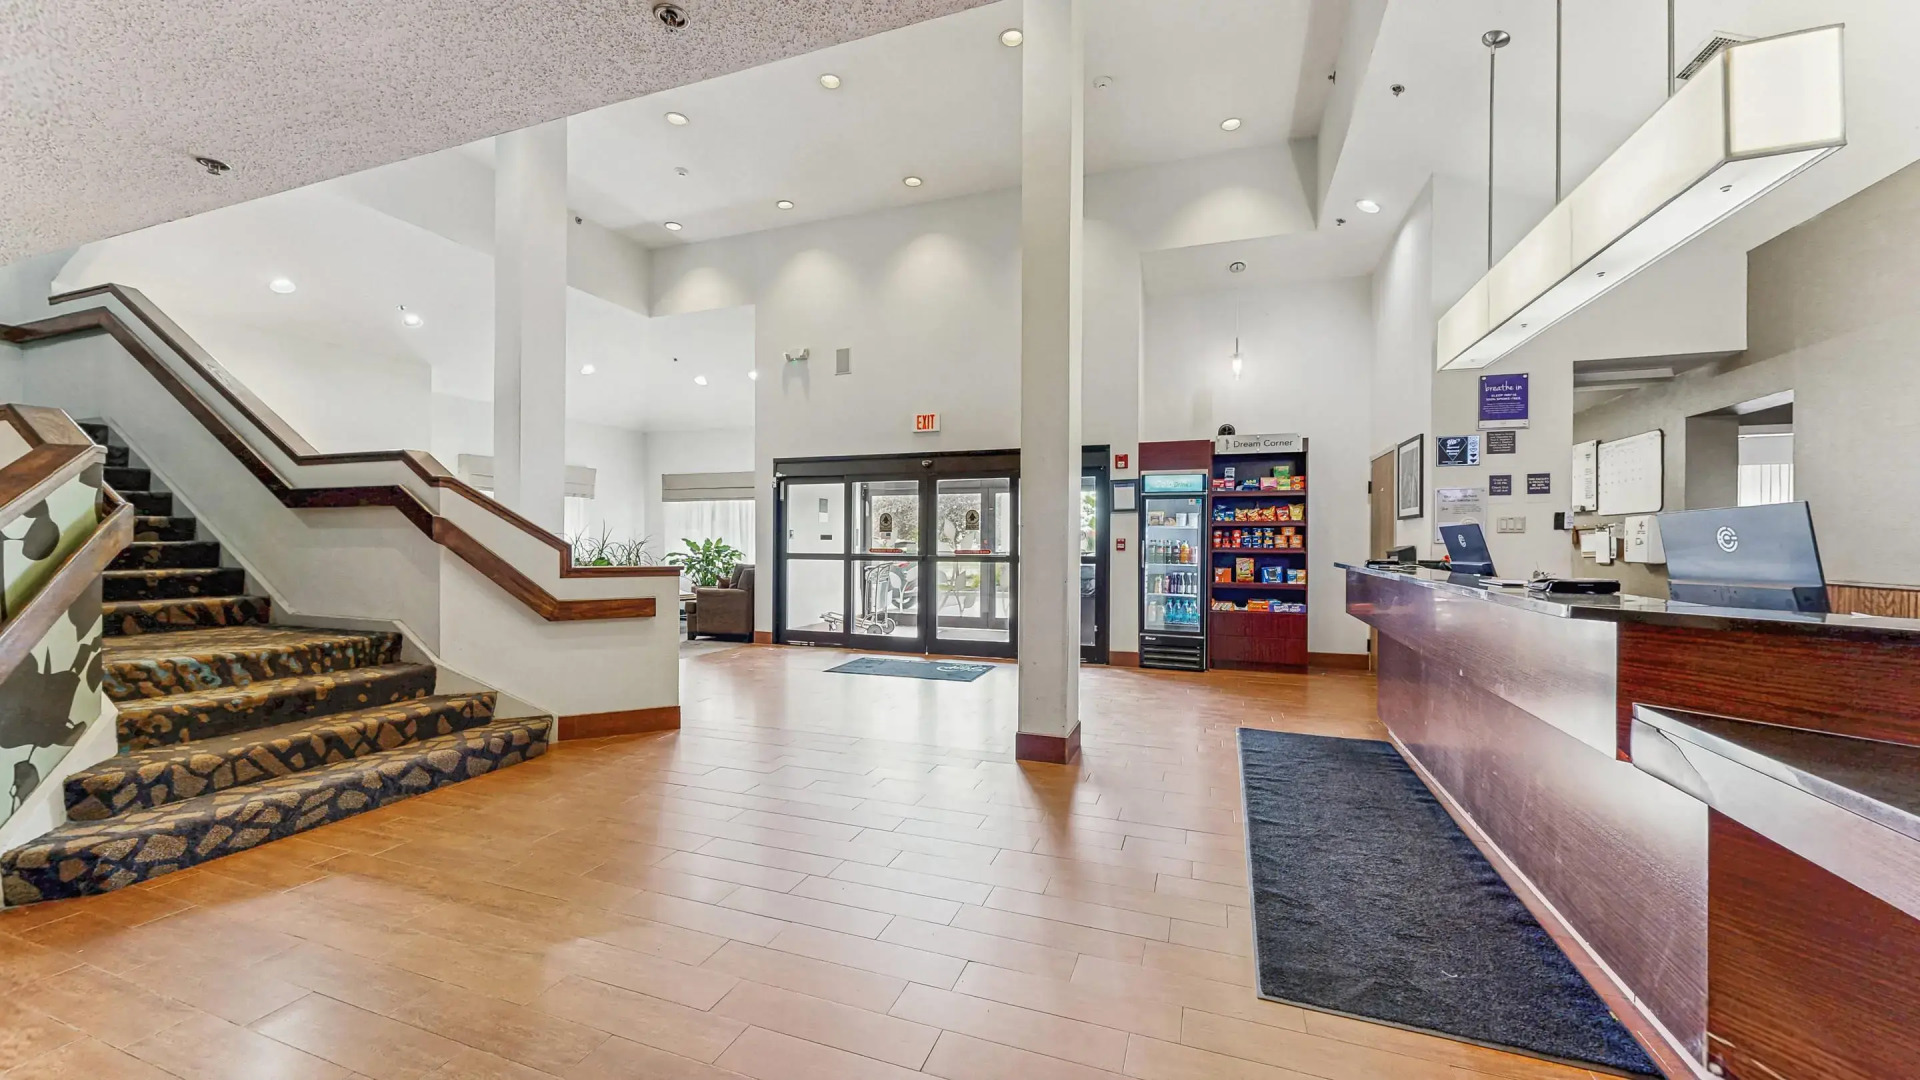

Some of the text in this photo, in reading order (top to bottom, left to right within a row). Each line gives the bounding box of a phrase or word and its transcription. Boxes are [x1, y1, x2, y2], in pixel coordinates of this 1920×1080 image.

[1484, 380, 1514, 392] breathe
[916, 414, 935, 430] EXIT
[1233, 439, 1293, 448] Dream Corner
